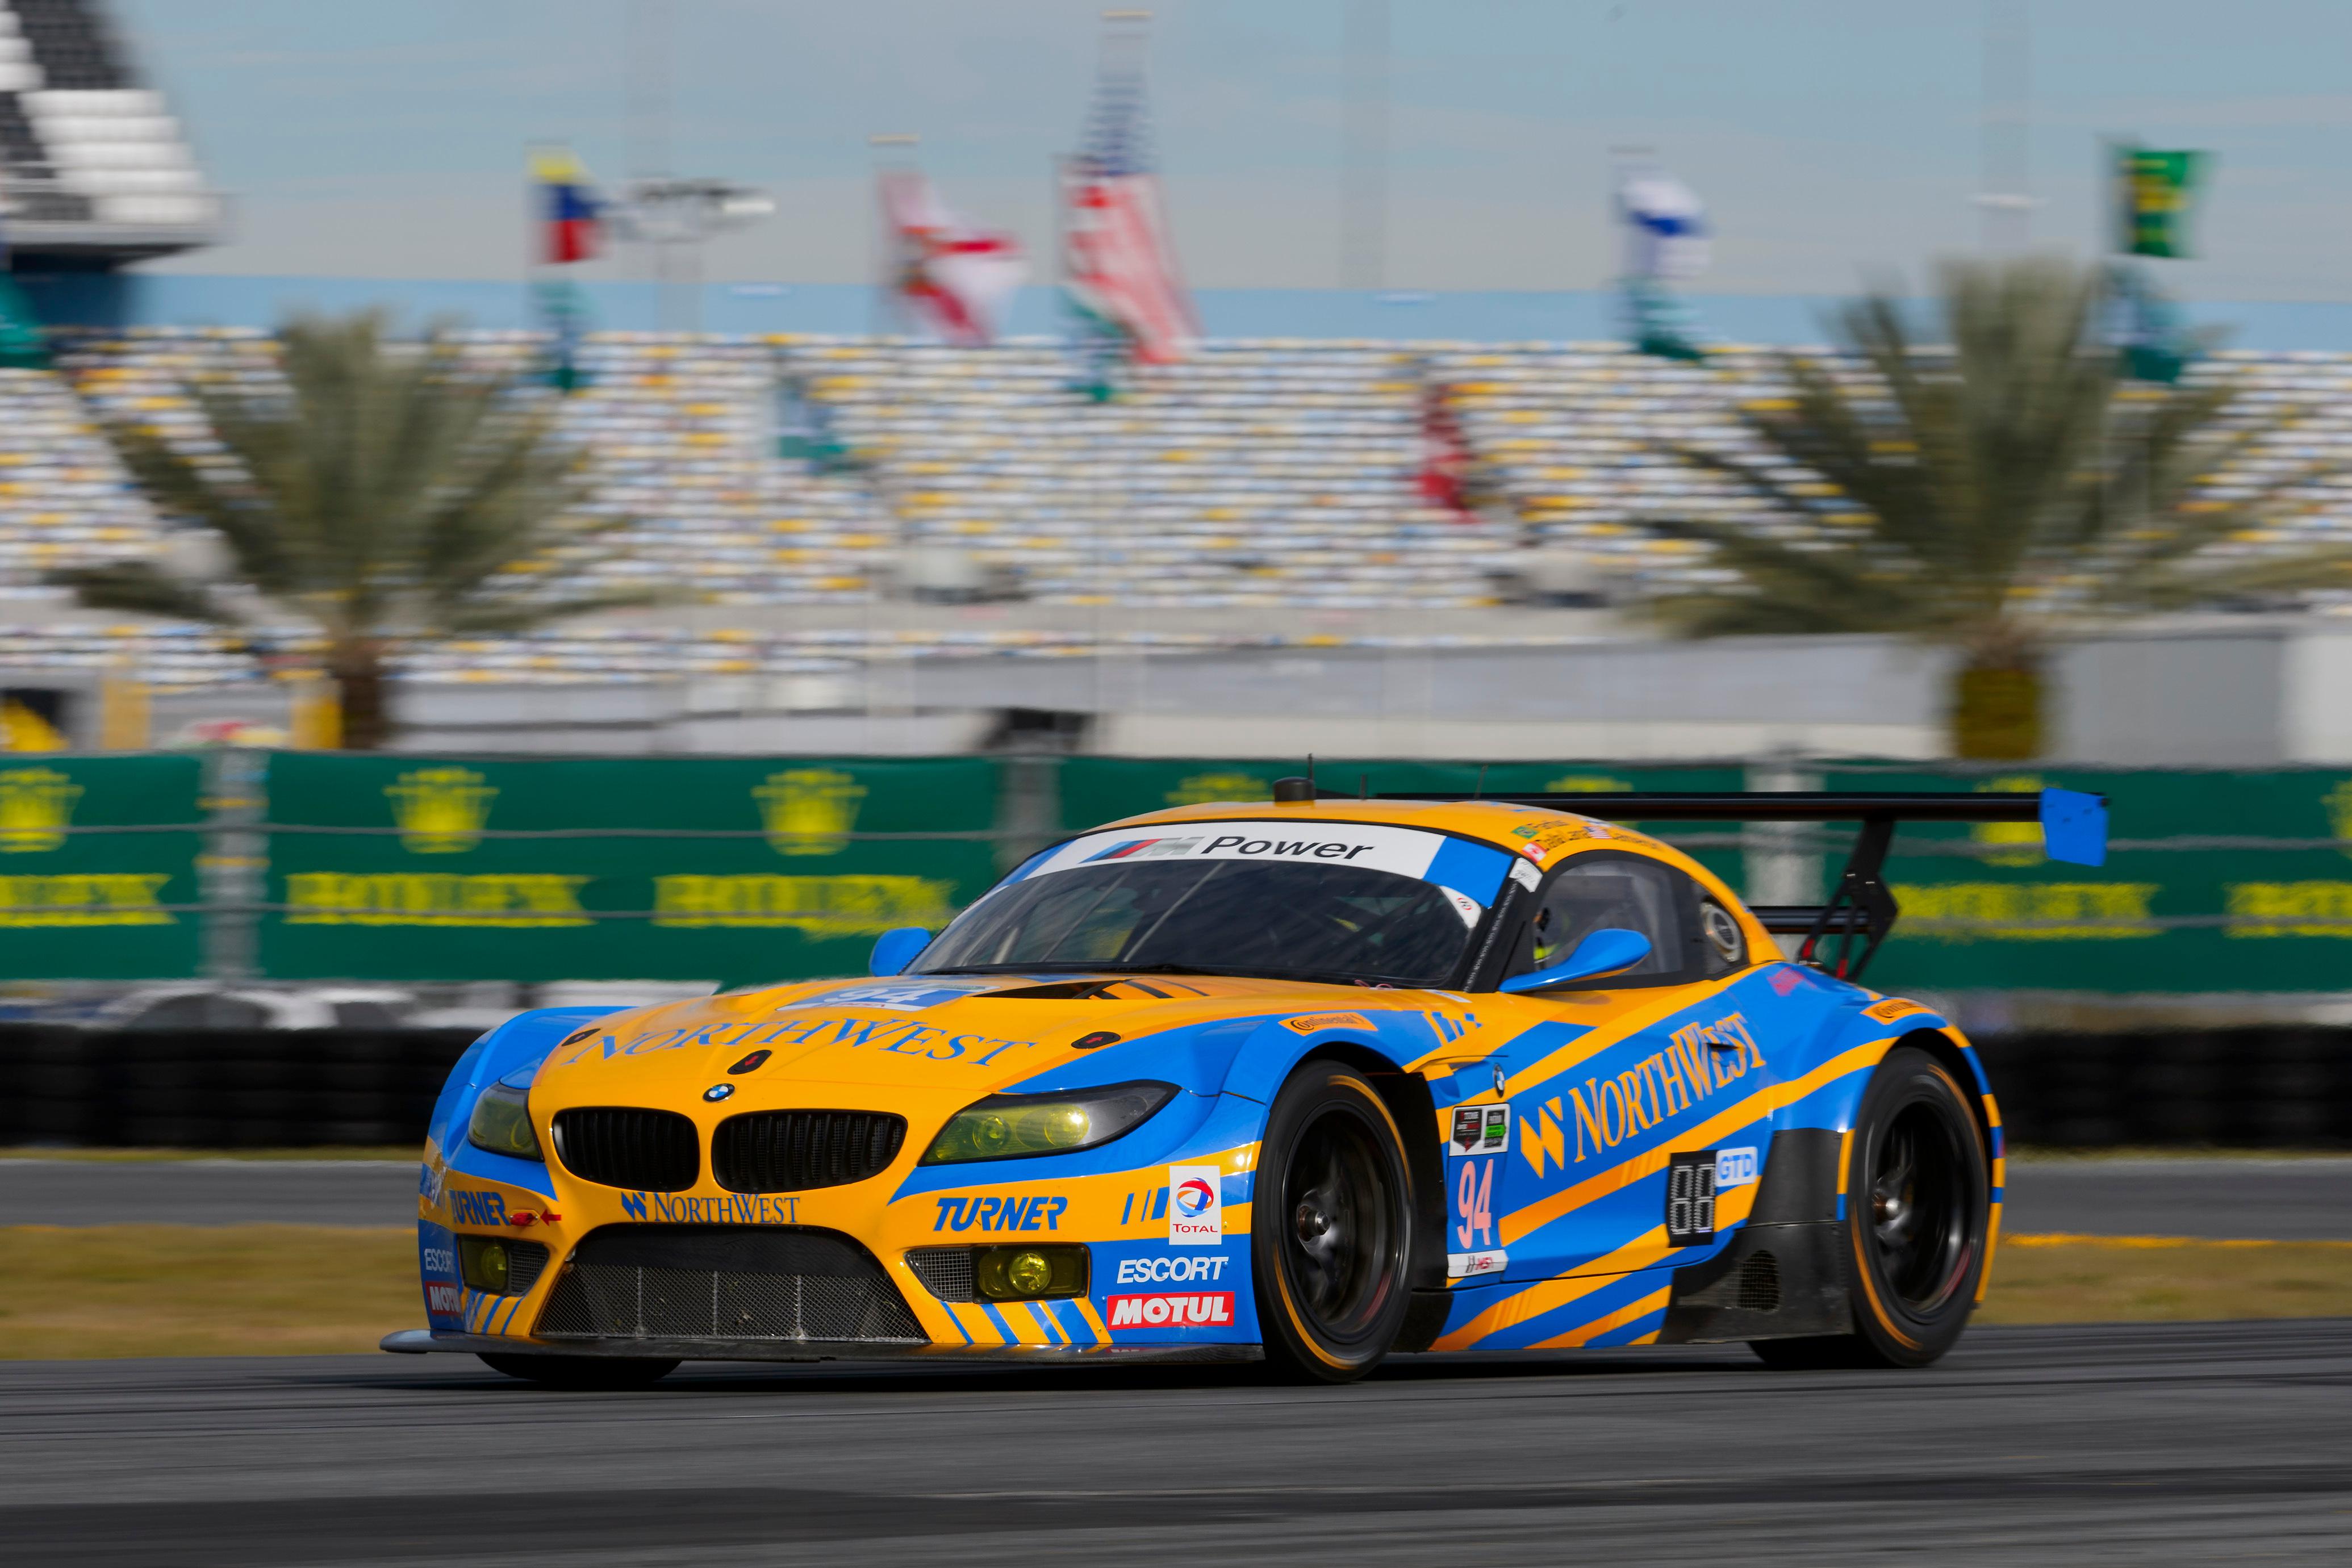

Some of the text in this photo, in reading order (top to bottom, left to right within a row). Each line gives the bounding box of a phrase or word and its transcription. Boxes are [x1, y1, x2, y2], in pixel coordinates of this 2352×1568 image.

[1201, 836, 1375, 860] Power
[824, 988, 941, 1005] 94
[1719, 1153, 1753, 1180] GTD
[933, 1196, 1068, 1231] TURNER
[1457, 1159, 1494, 1249] 94
[1172, 1223, 1218, 1234] TOTAL
[1116, 1256, 1230, 1285] ESCORT
[1111, 1296, 1229, 1325] MOTUL
